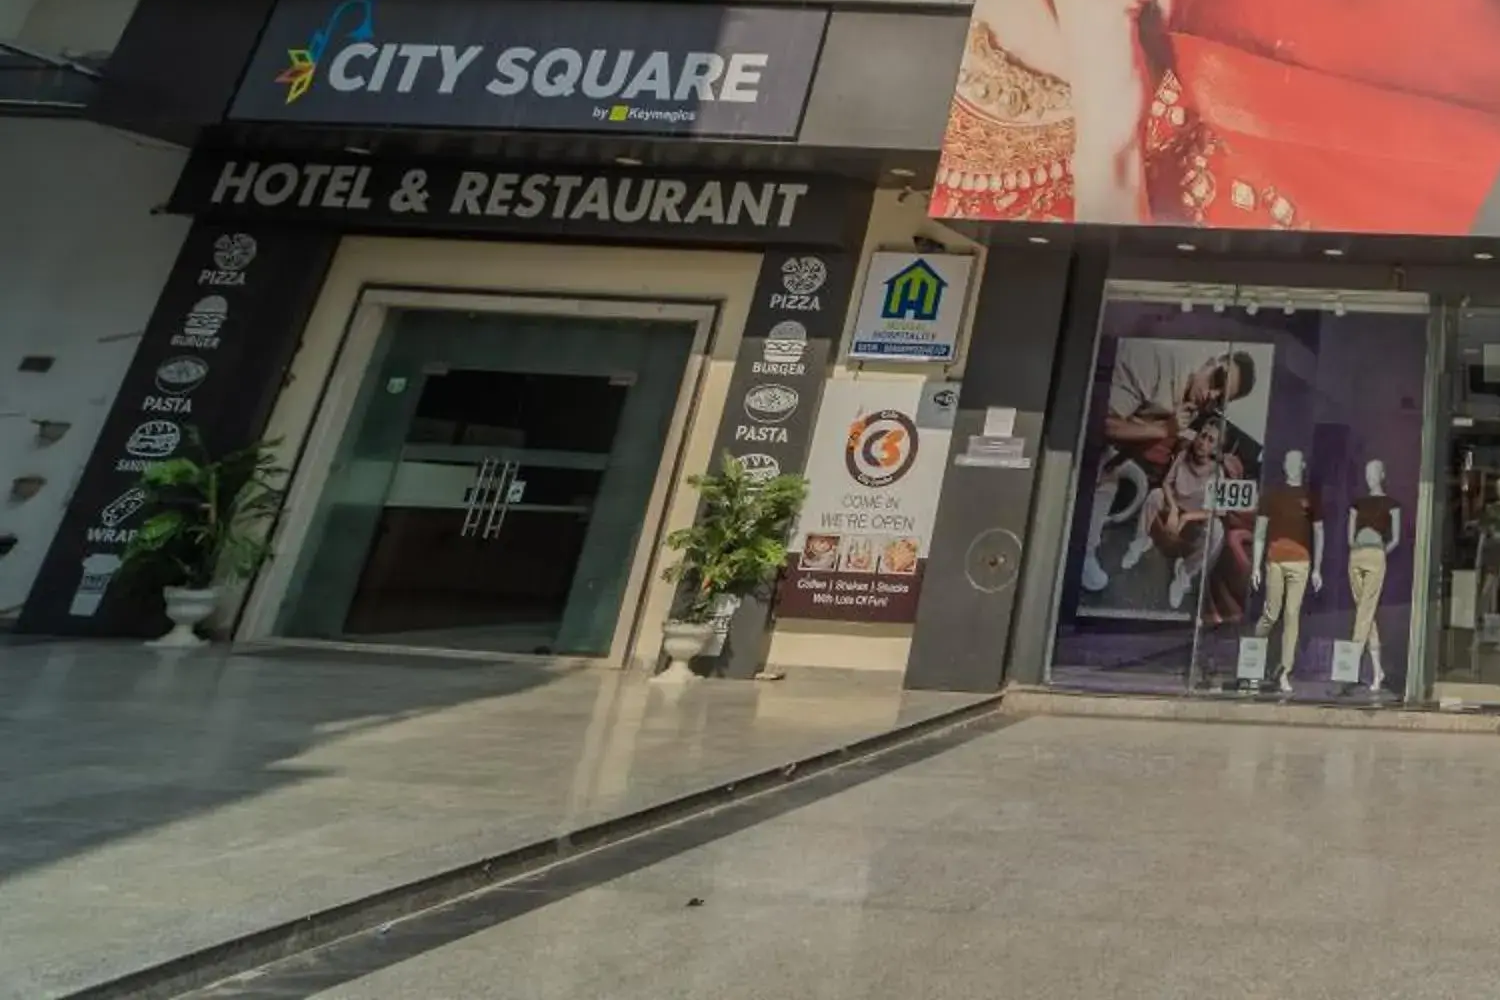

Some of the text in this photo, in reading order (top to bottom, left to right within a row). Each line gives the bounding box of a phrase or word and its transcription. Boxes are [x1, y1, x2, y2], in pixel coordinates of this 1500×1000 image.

[328, 42, 769, 103] CITY SQUARE
[591, 105, 609, 121] by
[211, 160, 808, 228] HOTEL & RESTAURANT
[198, 269, 246, 286] PIZZA
[769, 293, 821, 311] PIZZA
[170, 333, 222, 350] BURGER
[751, 361, 806, 376] BURGER
[142, 395, 193, 413] PASTA
[735, 425, 788, 443] PASTA
[841, 495, 882, 509] COME
[820, 511, 916, 531] WE'RE OPEN
